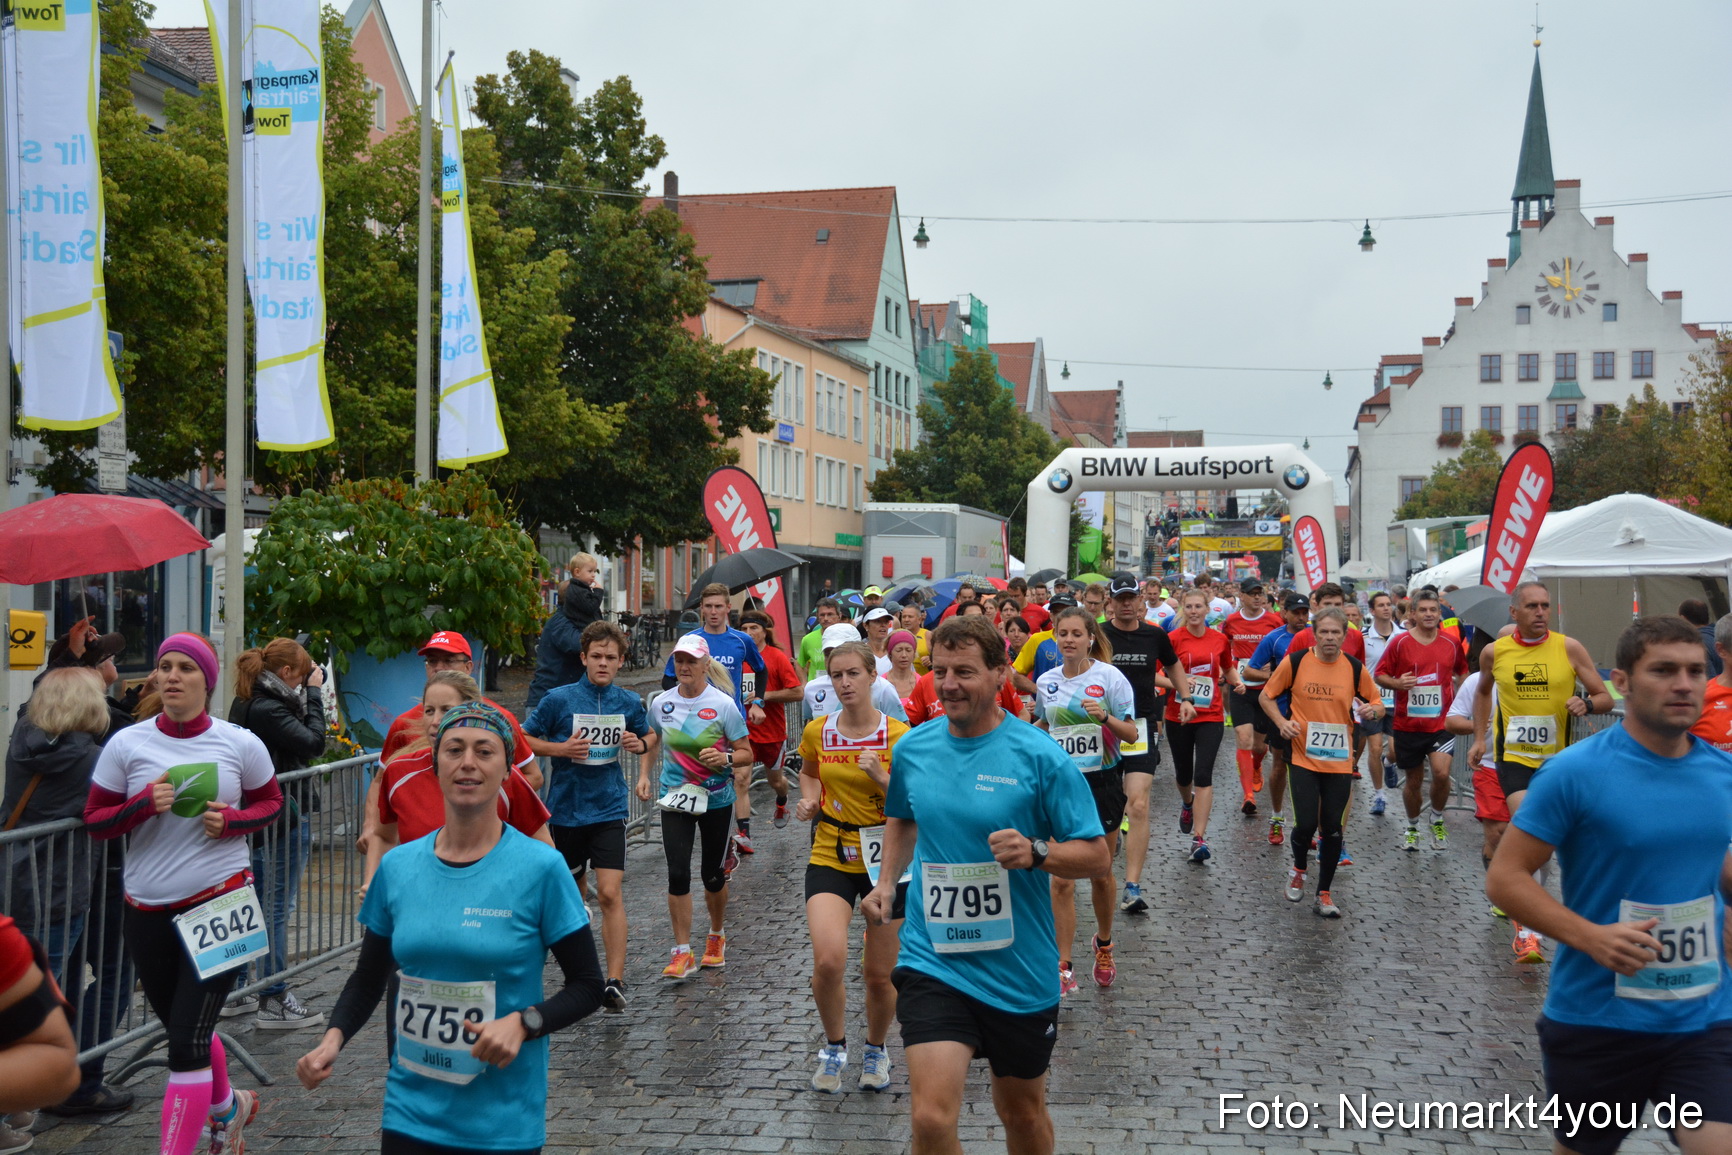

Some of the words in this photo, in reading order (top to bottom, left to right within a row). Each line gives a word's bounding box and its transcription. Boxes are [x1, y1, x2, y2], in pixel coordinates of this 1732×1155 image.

[1081, 457, 1148, 477] BMW
[1154, 455, 1274, 479] Laufsport
[1487, 464, 1545, 594] REWE
[1220, 539, 1243, 548] ZIEL
[711, 656, 734, 664] CAD
[1412, 694, 1439, 705] 3076
[580, 726, 621, 745] 2286
[1311, 732, 1344, 747] 2771
[1517, 726, 1548, 743] 209
[1521, 744, 1543, 753] Robert
[822, 754, 849, 763] MAX
[984, 774, 1018, 786] PFLEIDERER
[975, 784, 994, 792] Claus
[668, 793, 697, 812] 221
[953, 865, 999, 877] BOCK
[930, 884, 1002, 918] 2795
[471, 908, 513, 918] PFLEIDERER
[193, 905, 259, 949] 2642
[461, 919, 482, 928] Julia
[947, 927, 981, 940] Claus
[224, 943, 247, 959] Julia
[1656, 973, 1692, 986] Franz
[431, 984, 485, 998] BOCK
[401, 999, 484, 1045] 2758
[423, 1050, 452, 1069] Julia
